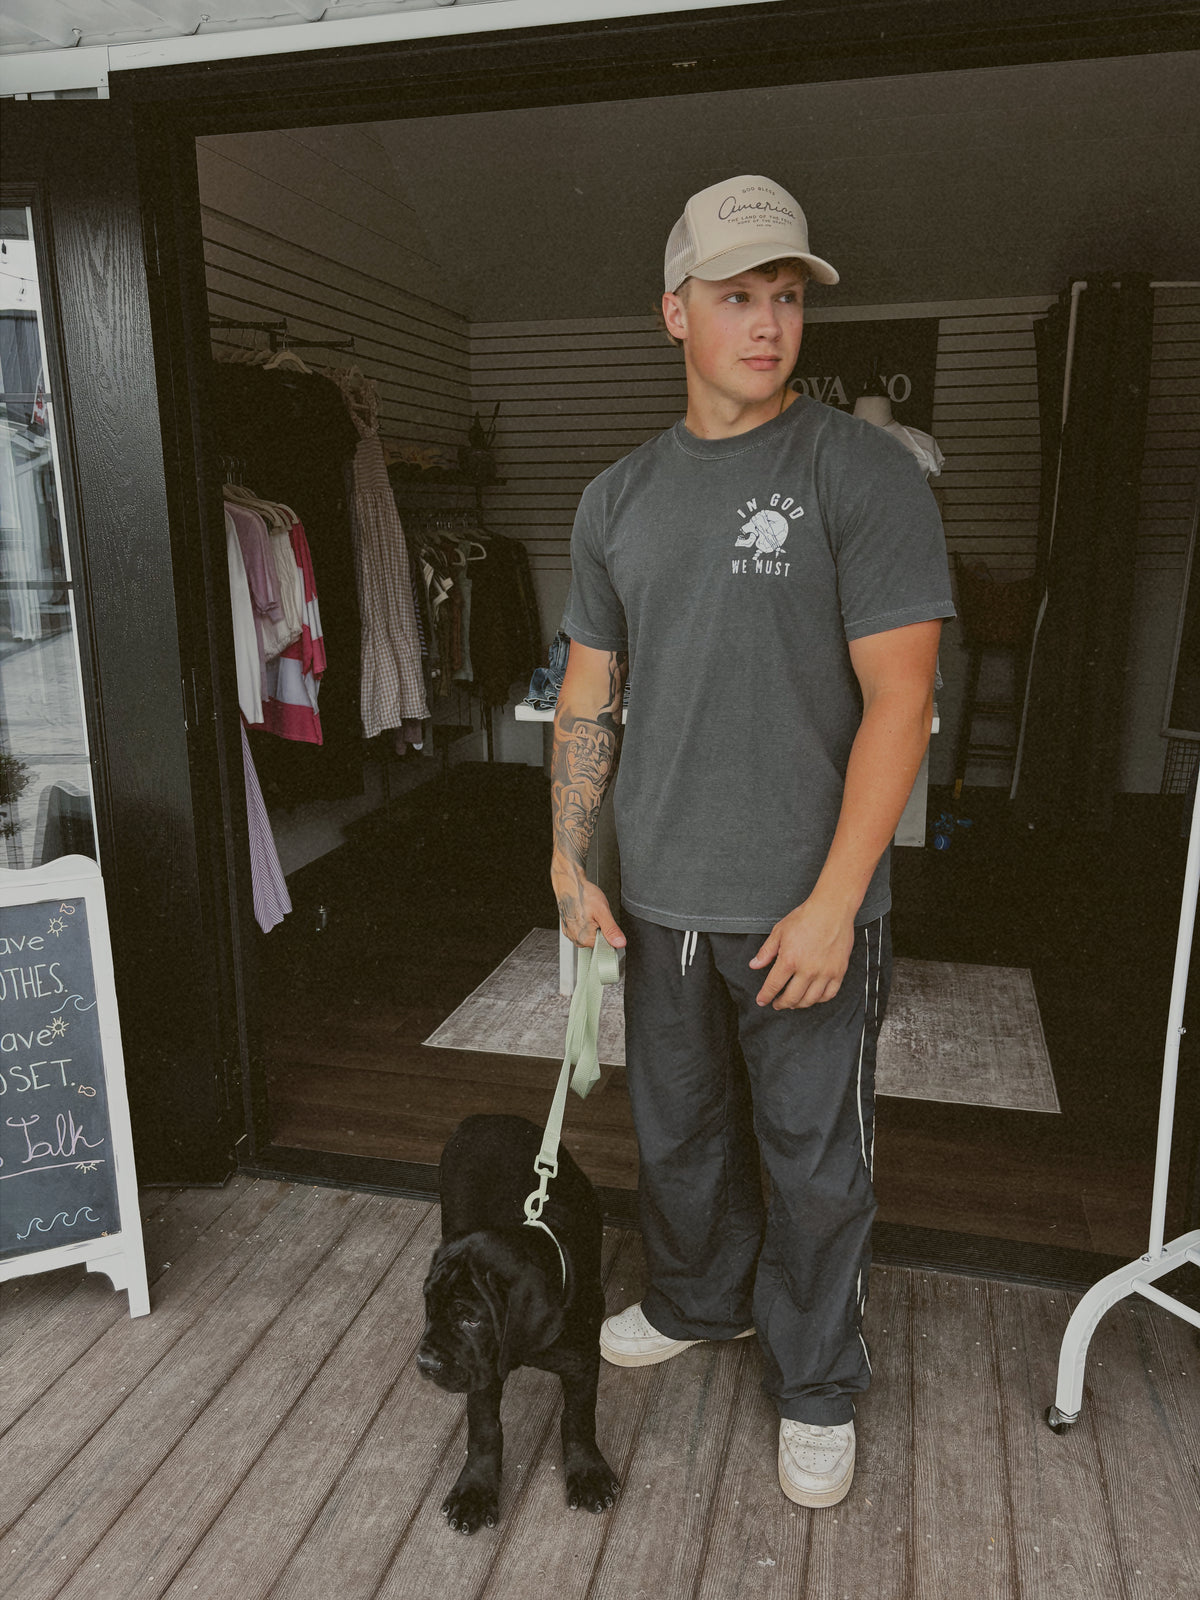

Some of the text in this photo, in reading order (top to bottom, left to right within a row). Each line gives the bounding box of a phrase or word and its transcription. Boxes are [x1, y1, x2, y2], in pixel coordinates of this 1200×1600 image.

[718, 195, 797, 220] America
[736, 493, 805, 520] IN GOD
[731, 559, 791, 577] WE MUST
[5, 1109, 105, 1164] Talk
